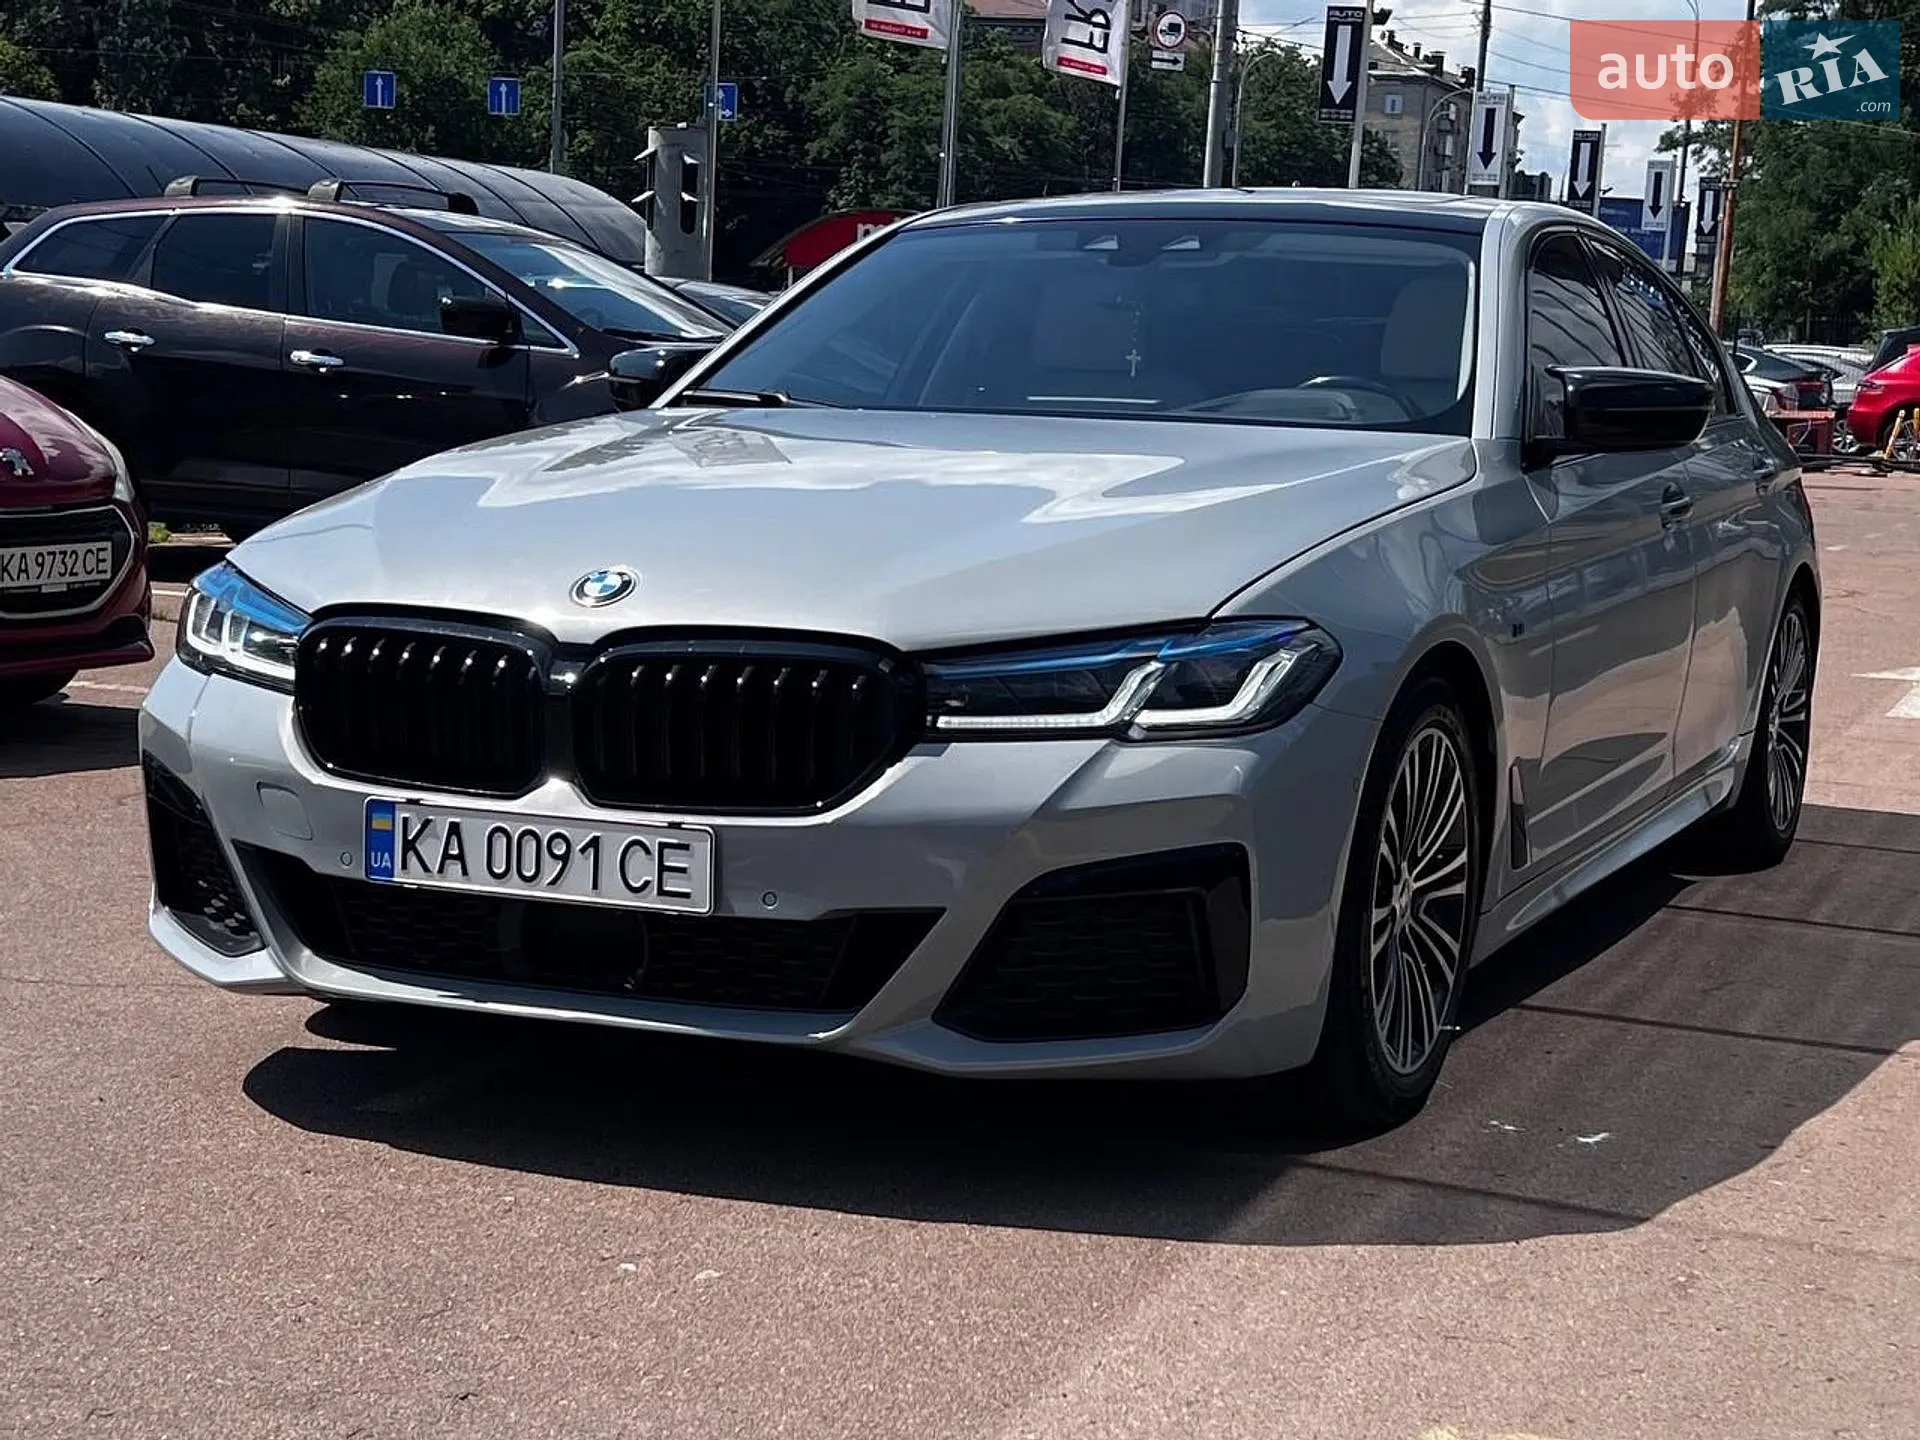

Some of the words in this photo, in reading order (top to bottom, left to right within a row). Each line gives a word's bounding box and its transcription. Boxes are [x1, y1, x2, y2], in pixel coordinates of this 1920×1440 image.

[1, 552, 30, 582] KA
[34, 550, 79, 580] 9732
[83, 547, 108, 576] CE
[370, 851, 393, 868] UA
[400, 815, 469, 877] KA
[485, 824, 603, 891] 0091
[618, 838, 692, 899] CE
